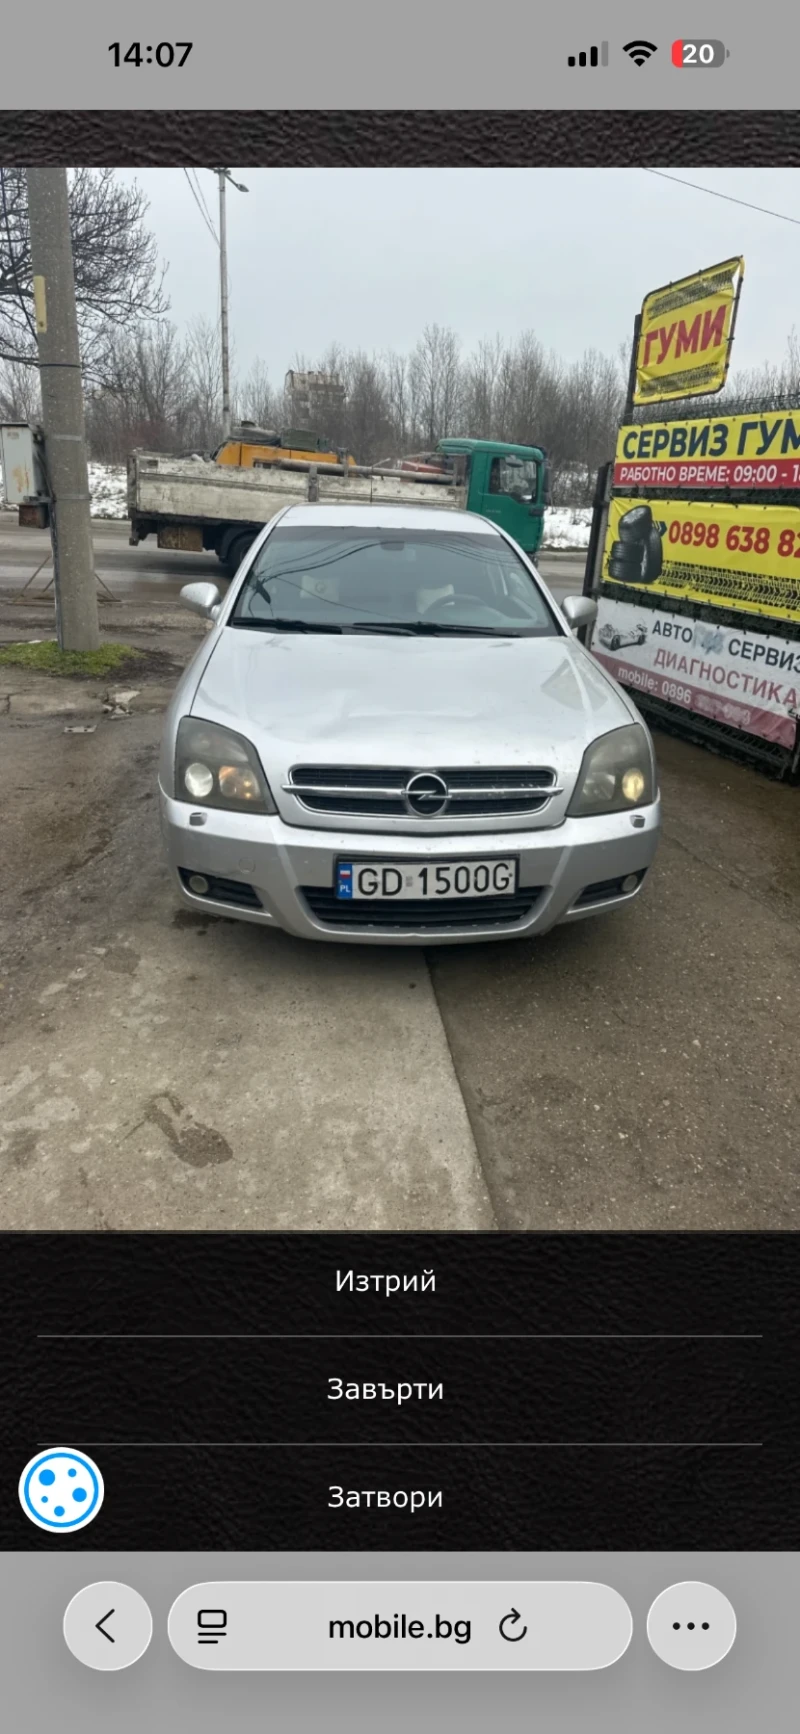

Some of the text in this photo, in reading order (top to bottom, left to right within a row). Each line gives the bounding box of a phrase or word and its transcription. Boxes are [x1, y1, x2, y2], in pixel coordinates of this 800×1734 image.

[108, 41, 194, 68] 14:07
[682, 43, 715, 64] 20
[642, 304, 727, 367] ГУМИ
[622, 424, 729, 460] СЕРВИЗ
[619, 466, 676, 482] РАБОТНО
[678, 465, 731, 482] ВРЕМЕ:
[733, 464, 778, 483] 09:00
[668, 520, 721, 548] 0898
[725, 525, 771, 555] 638
[652, 620, 693, 643] АВТО
[617, 667, 693, 704] mobile: 0896
[653, 648, 798, 709] ДИАГНОСТИКА
[340, 862, 511, 896] PL GD 1500G
[335, 1269, 436, 1297] Изтрий
[327, 1377, 443, 1405] Завърти
[328, 1485, 442, 1513] Затвори
[328, 1613, 472, 1645] mobile.bg
